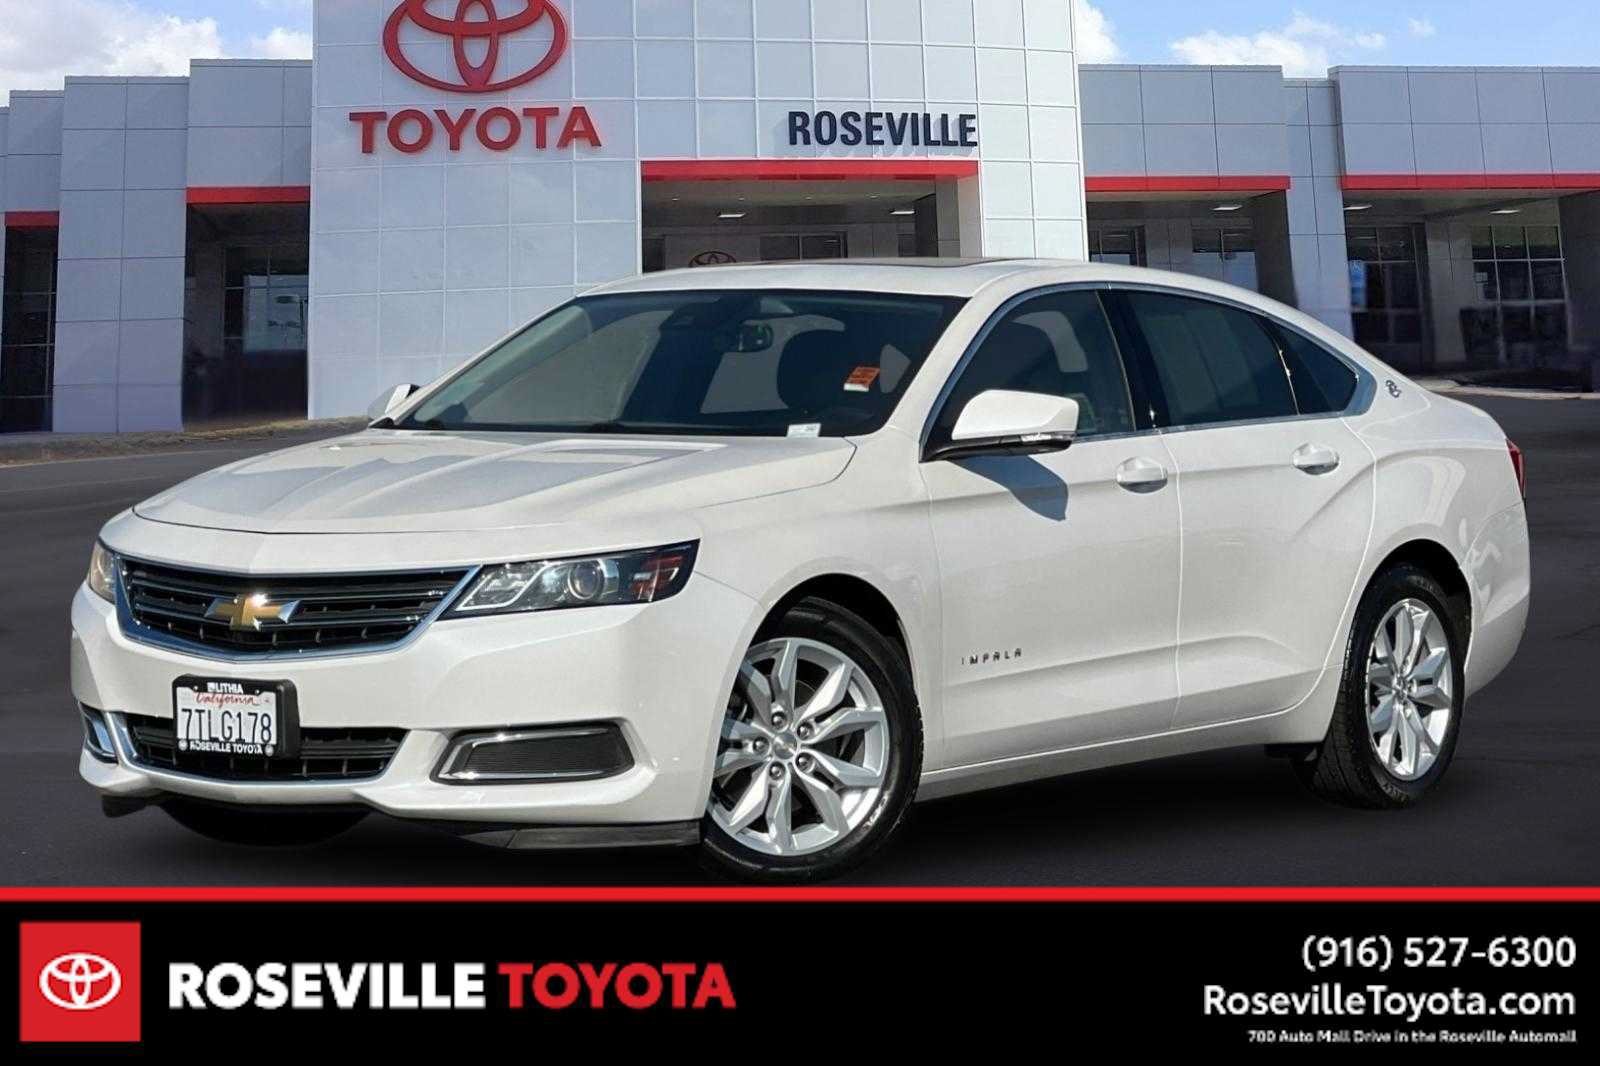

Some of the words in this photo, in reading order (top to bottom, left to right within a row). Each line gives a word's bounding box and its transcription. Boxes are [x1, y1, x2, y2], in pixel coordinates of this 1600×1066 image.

[349, 105, 603, 154] TOYOTA
[788, 110, 978, 148] ROSEVILLE
[961, 648, 1022, 665] IMPALA
[215, 682, 244, 694] LITHIA
[195, 692, 260, 708] California
[181, 708, 272, 744] 7TLG178
[189, 740, 231, 753] ROSEVILLE
[232, 743, 263, 755] TOYOTA
